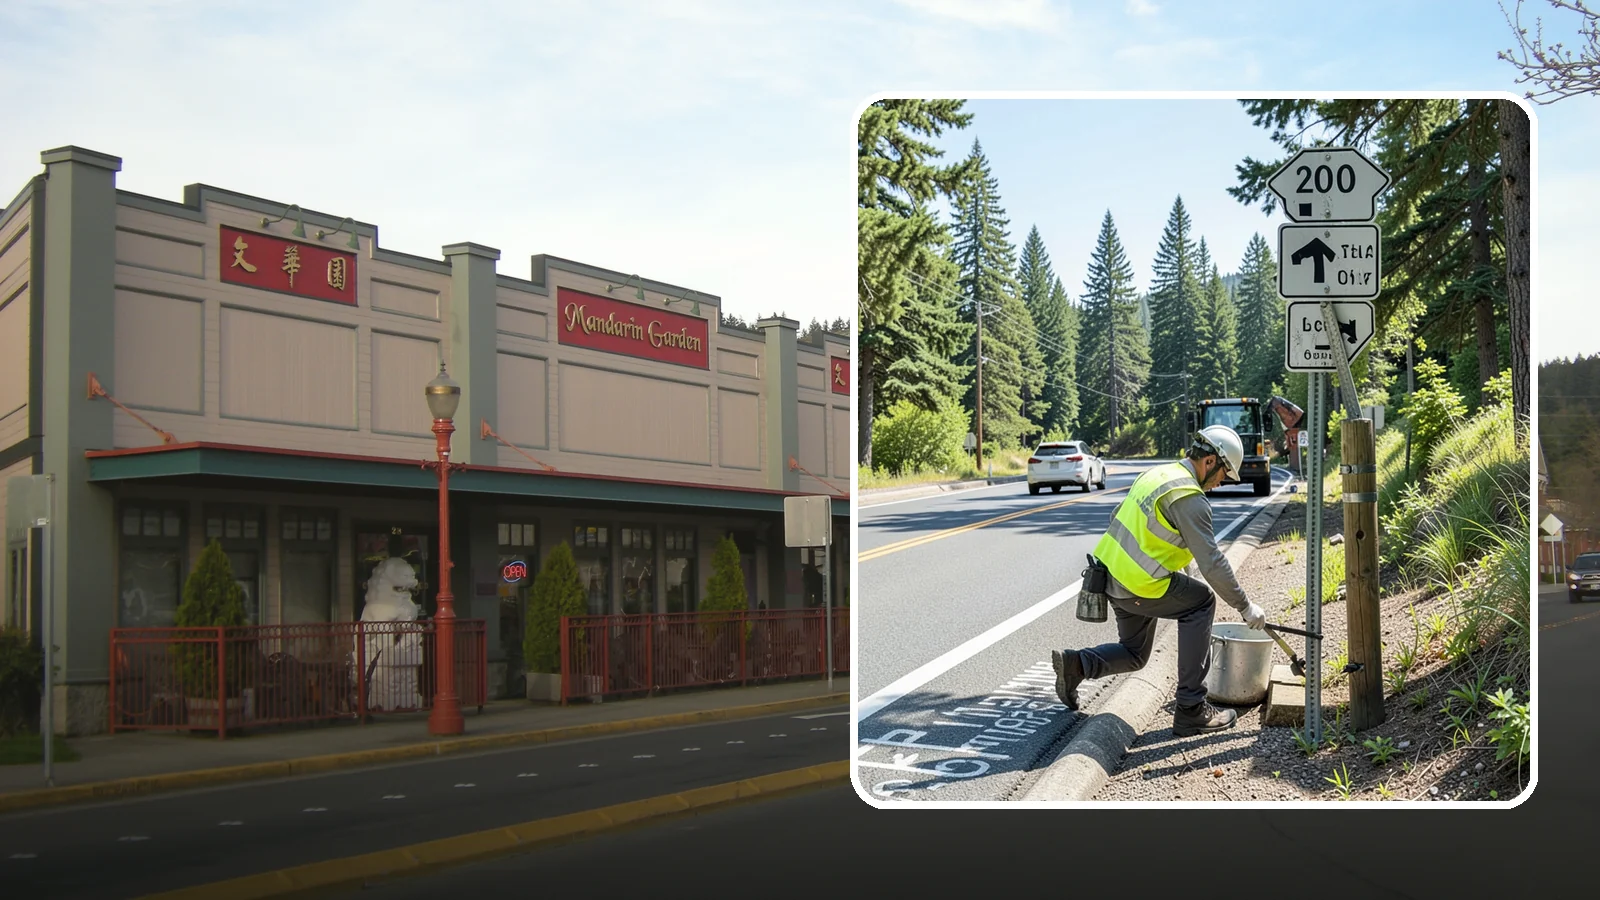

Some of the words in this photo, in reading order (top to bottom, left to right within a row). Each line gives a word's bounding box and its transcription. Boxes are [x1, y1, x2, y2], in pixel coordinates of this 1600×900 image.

[1296, 164, 1356, 194] 200
[231, 236, 346, 291] 文華園
[565, 302, 643, 341] Mandarin
[648, 320, 701, 352] Garden
[503, 565, 526, 578] OPEN
